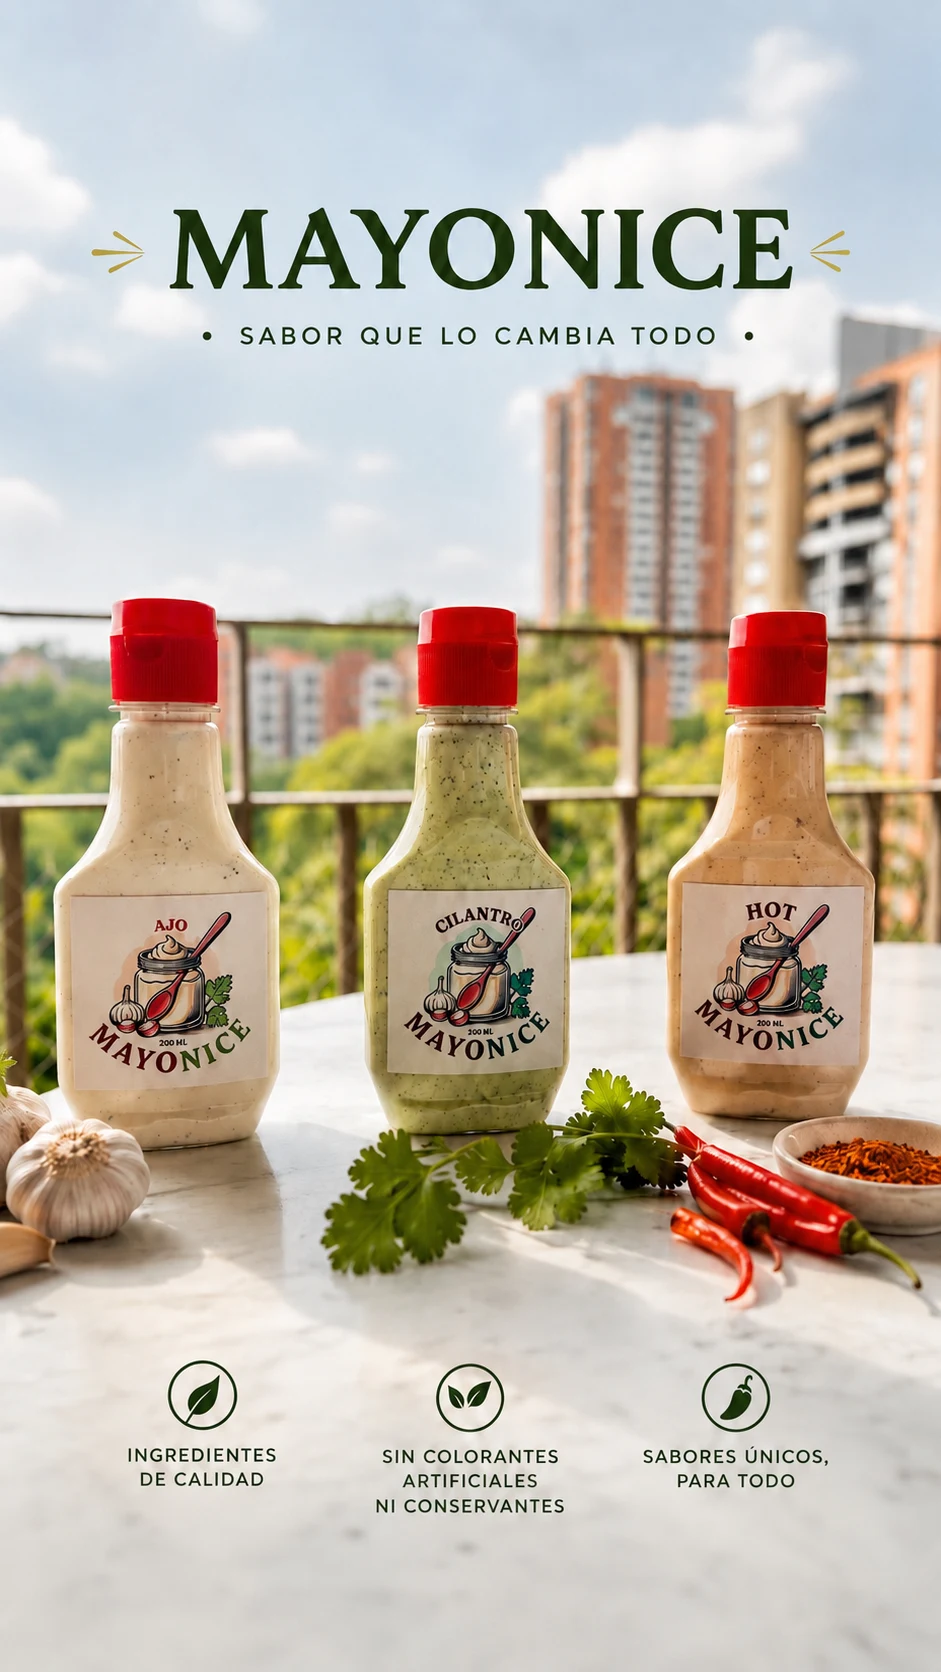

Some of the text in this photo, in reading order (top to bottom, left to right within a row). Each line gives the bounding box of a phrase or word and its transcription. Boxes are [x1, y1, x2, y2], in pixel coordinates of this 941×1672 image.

[435, 906, 524, 934] CILANTRO
[745, 901, 797, 921] HOT
[154, 918, 188, 932] AJO
[467, 1028, 482, 1036] 200
[694, 999, 845, 1051] MAYONICE
[756, 1019, 771, 1027] 200
[88, 1018, 252, 1074] MAYONICE
[159, 1039, 175, 1047] 200
[404, 1011, 551, 1061] MAYONICE
